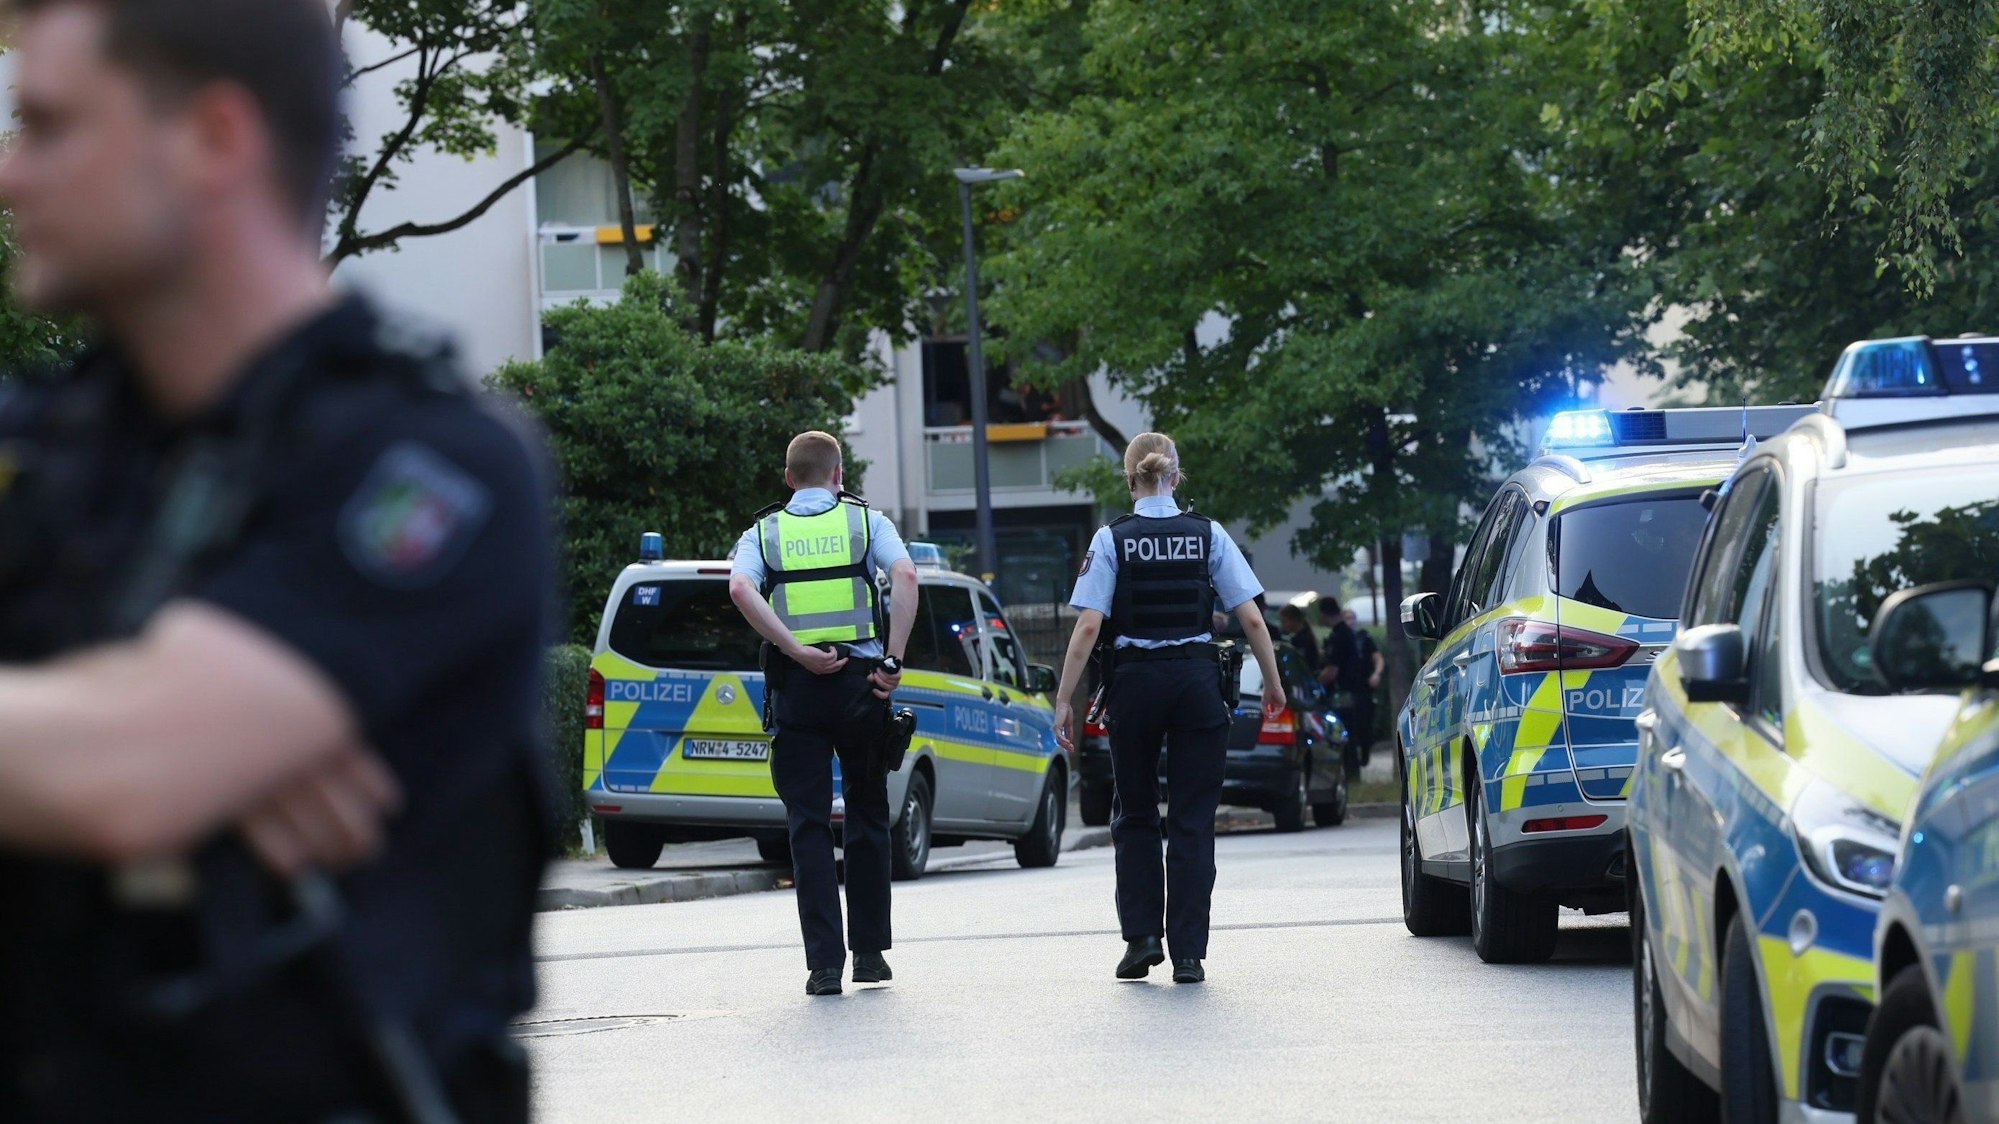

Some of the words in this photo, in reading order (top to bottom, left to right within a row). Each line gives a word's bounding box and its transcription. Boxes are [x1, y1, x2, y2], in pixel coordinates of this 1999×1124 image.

[786, 536, 844, 557] POLIZEI
[1123, 536, 1204, 561] POLIZEI
[641, 596, 651, 605] W
[611, 681, 692, 702] POLIZEI
[1569, 687, 1644, 711] POLIZ
[954, 705, 988, 734] POLIZEI
